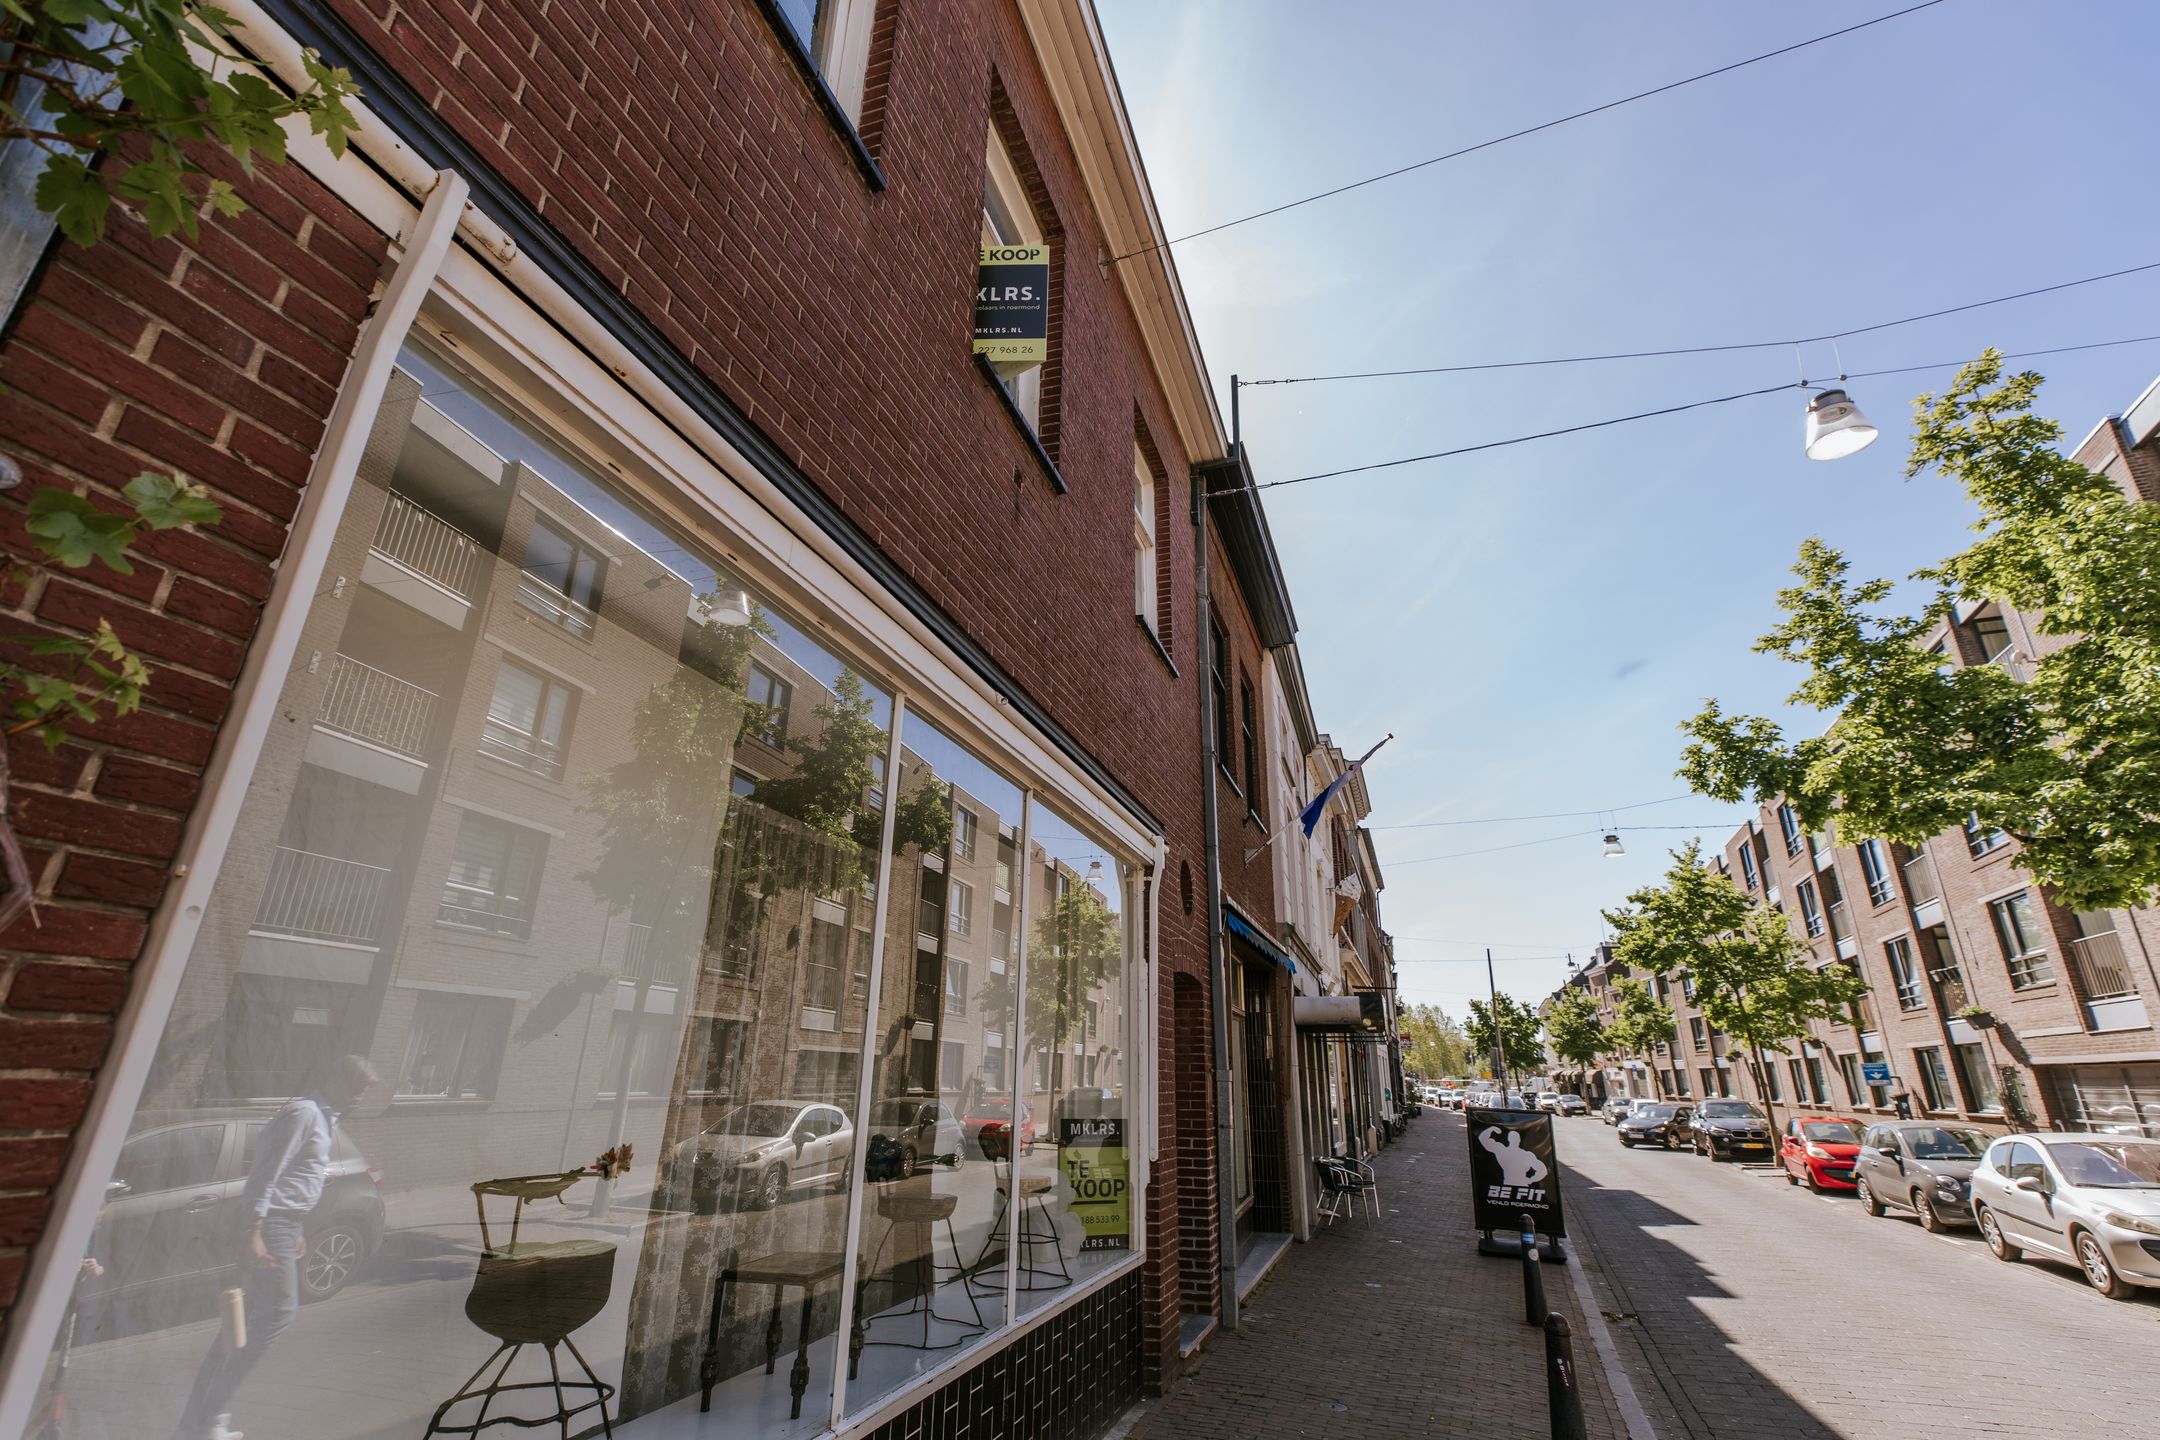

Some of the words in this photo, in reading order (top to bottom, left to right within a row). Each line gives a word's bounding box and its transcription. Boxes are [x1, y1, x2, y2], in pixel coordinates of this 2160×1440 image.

[989, 249, 1040, 261] KOOP
[999, 346, 1018, 354] 968
[1021, 346, 1034, 354] 26
[1070, 1123, 1120, 1135] MKLRS.
[1067, 1160, 1090, 1178] TE
[1070, 1179, 1125, 1198] KOOP
[1488, 1185, 1512, 1199] BE
[1516, 1187, 1546, 1202] FIT
[1510, 1201, 1549, 1210] ROERMOND
[1096, 1215, 1109, 1224] 533
[1110, 1214, 1120, 1223] 99
